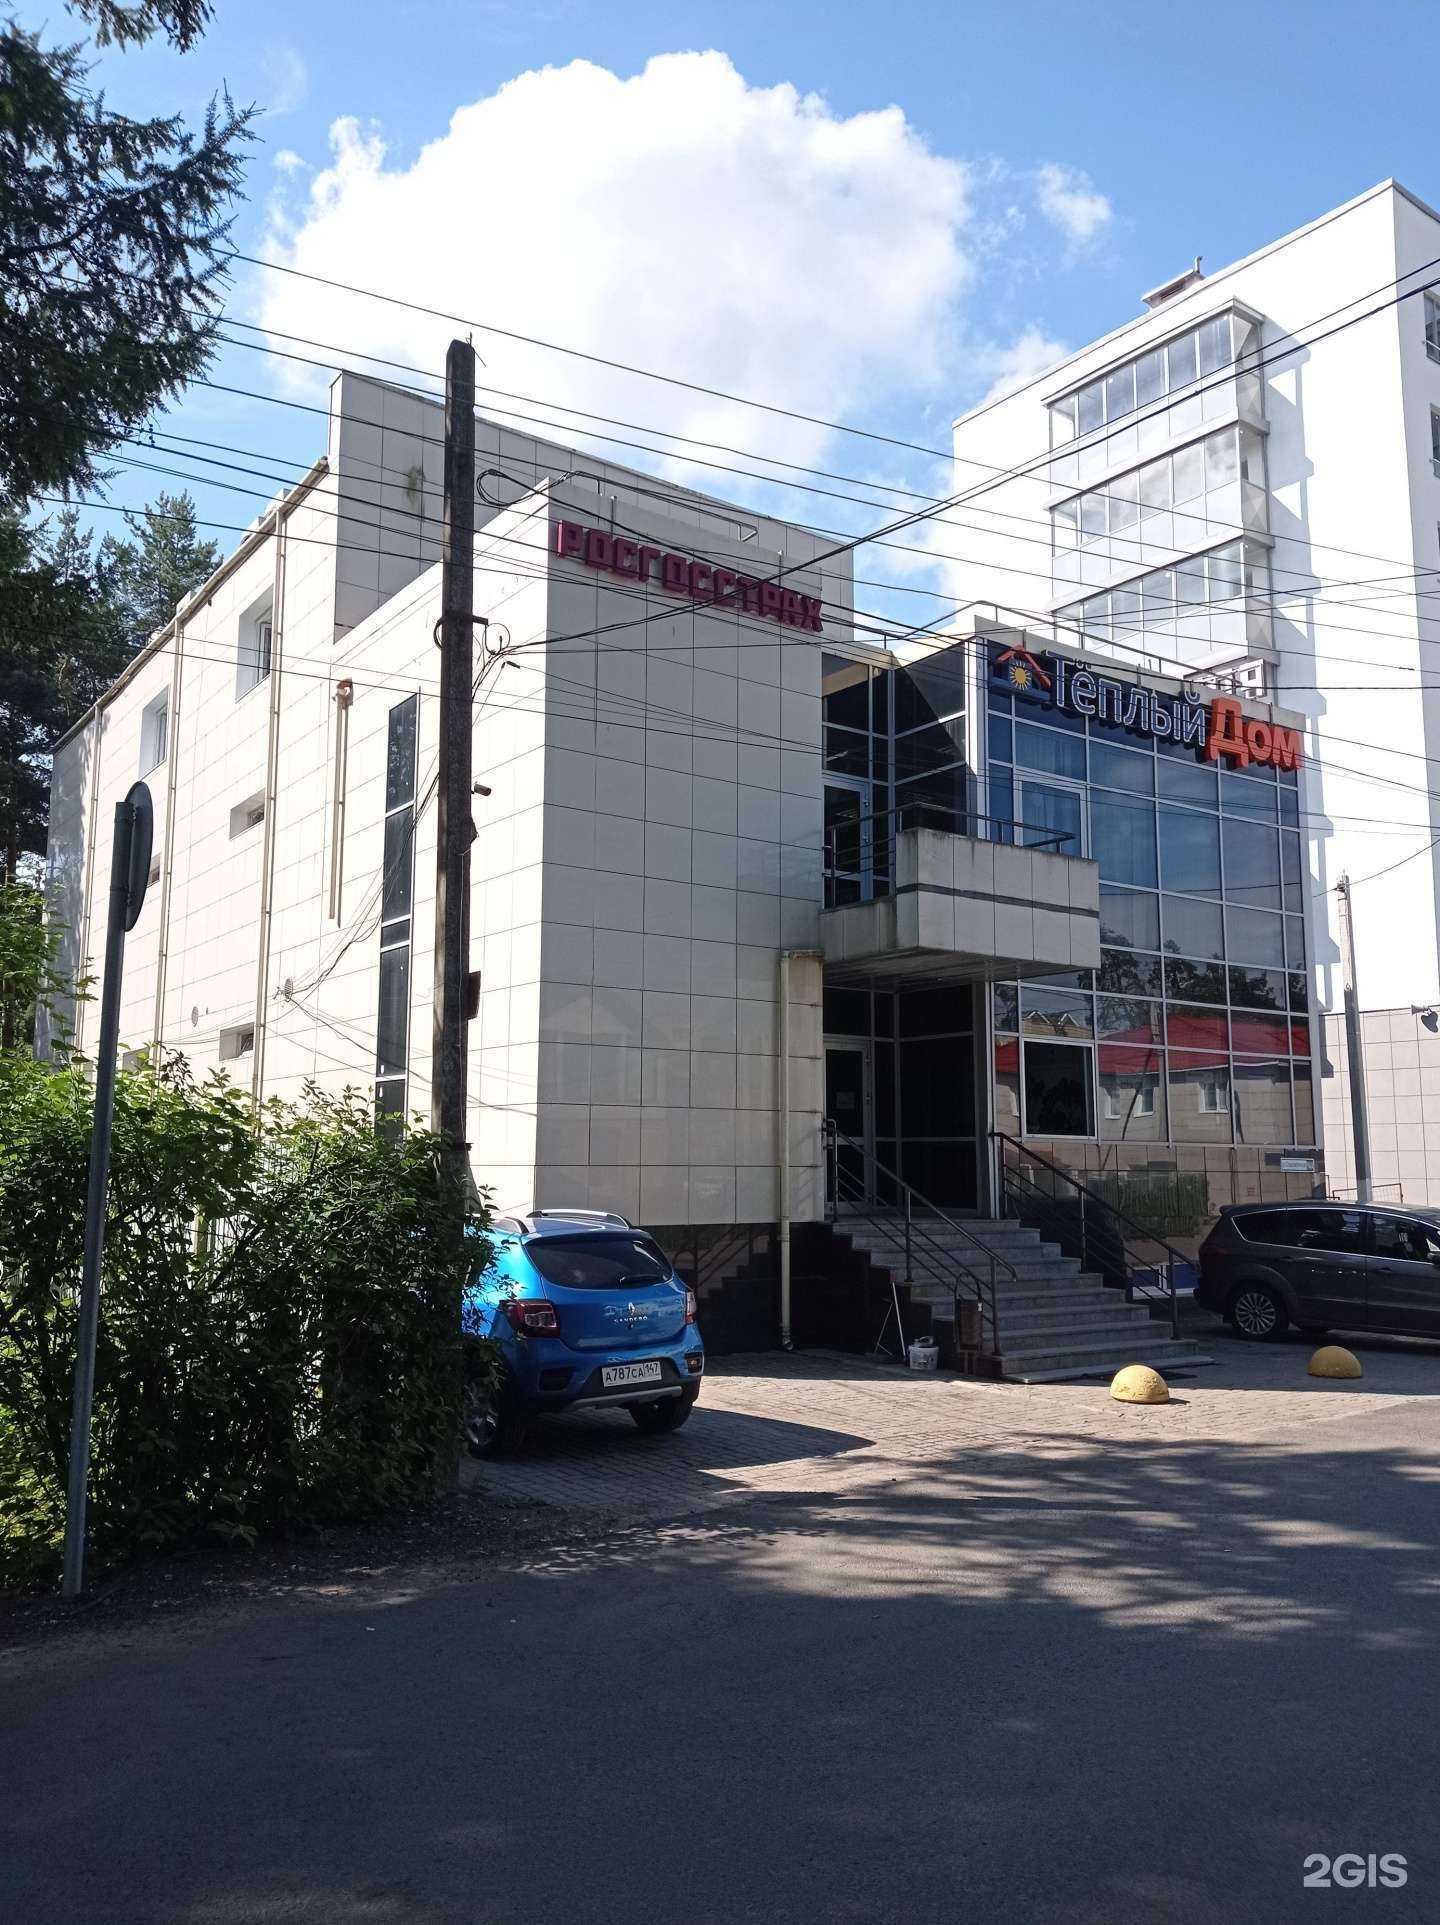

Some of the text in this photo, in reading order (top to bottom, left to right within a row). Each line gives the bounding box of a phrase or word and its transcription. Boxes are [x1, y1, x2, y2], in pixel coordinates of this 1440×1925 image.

[557, 520, 823, 632] РОСГОССТРАХ
[1046, 650, 1301, 770] Тёплый Дом
